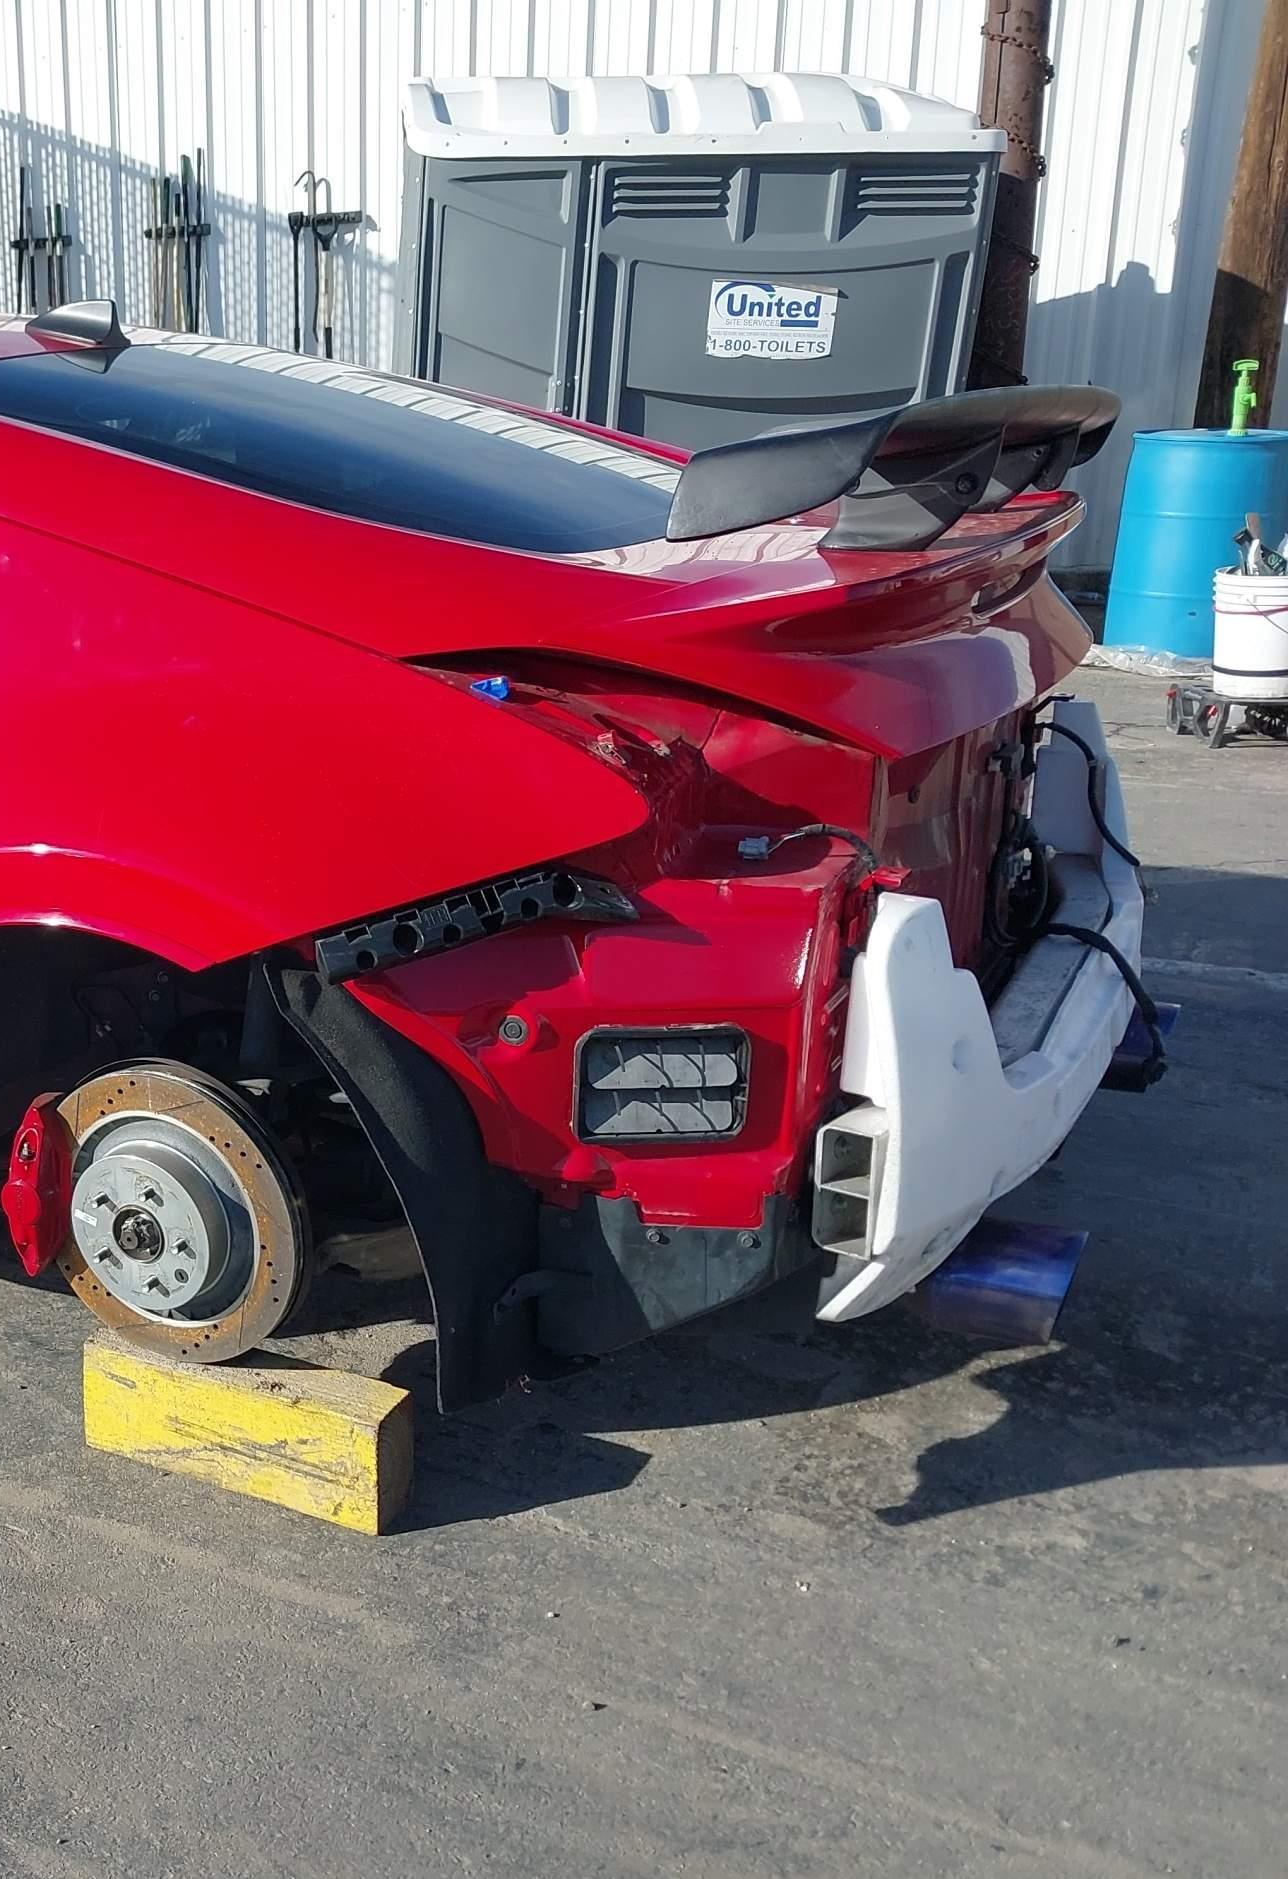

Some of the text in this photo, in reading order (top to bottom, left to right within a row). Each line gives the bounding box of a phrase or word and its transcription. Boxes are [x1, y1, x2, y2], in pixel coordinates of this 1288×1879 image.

[727, 293, 822, 318] United
[743, 319, 780, 327] SERVICES
[710, 338, 827, 354] 1-800-TOILETS
